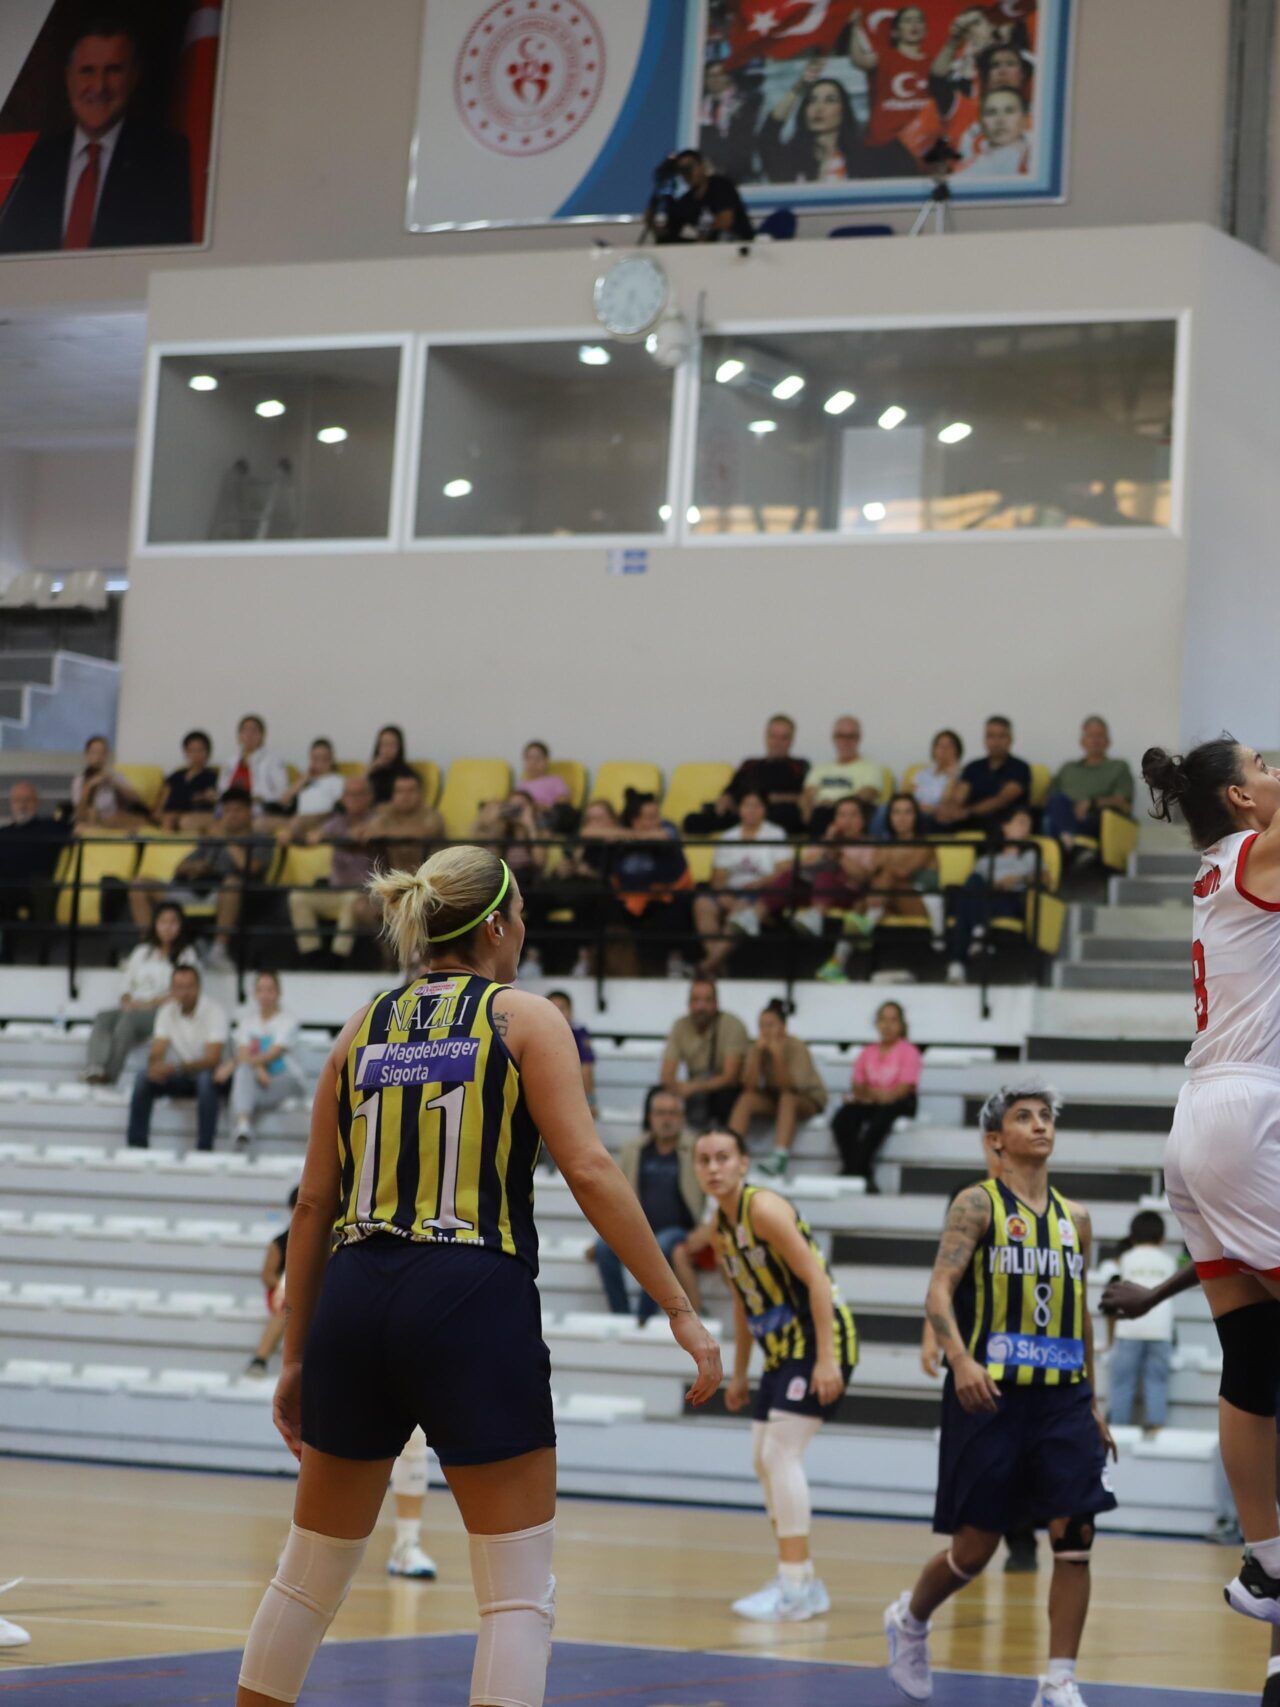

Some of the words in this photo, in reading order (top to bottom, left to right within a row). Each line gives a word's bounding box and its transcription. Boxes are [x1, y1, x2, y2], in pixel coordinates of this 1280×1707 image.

[384, 995, 473, 1031] NAZLI
[385, 1040, 478, 1065] Magdeburger
[380, 1064, 429, 1086] Sigorta
[353, 1084, 474, 1231] 11
[989, 1246, 1060, 1277] YALOVA
[1034, 1282, 1053, 1328] 8
